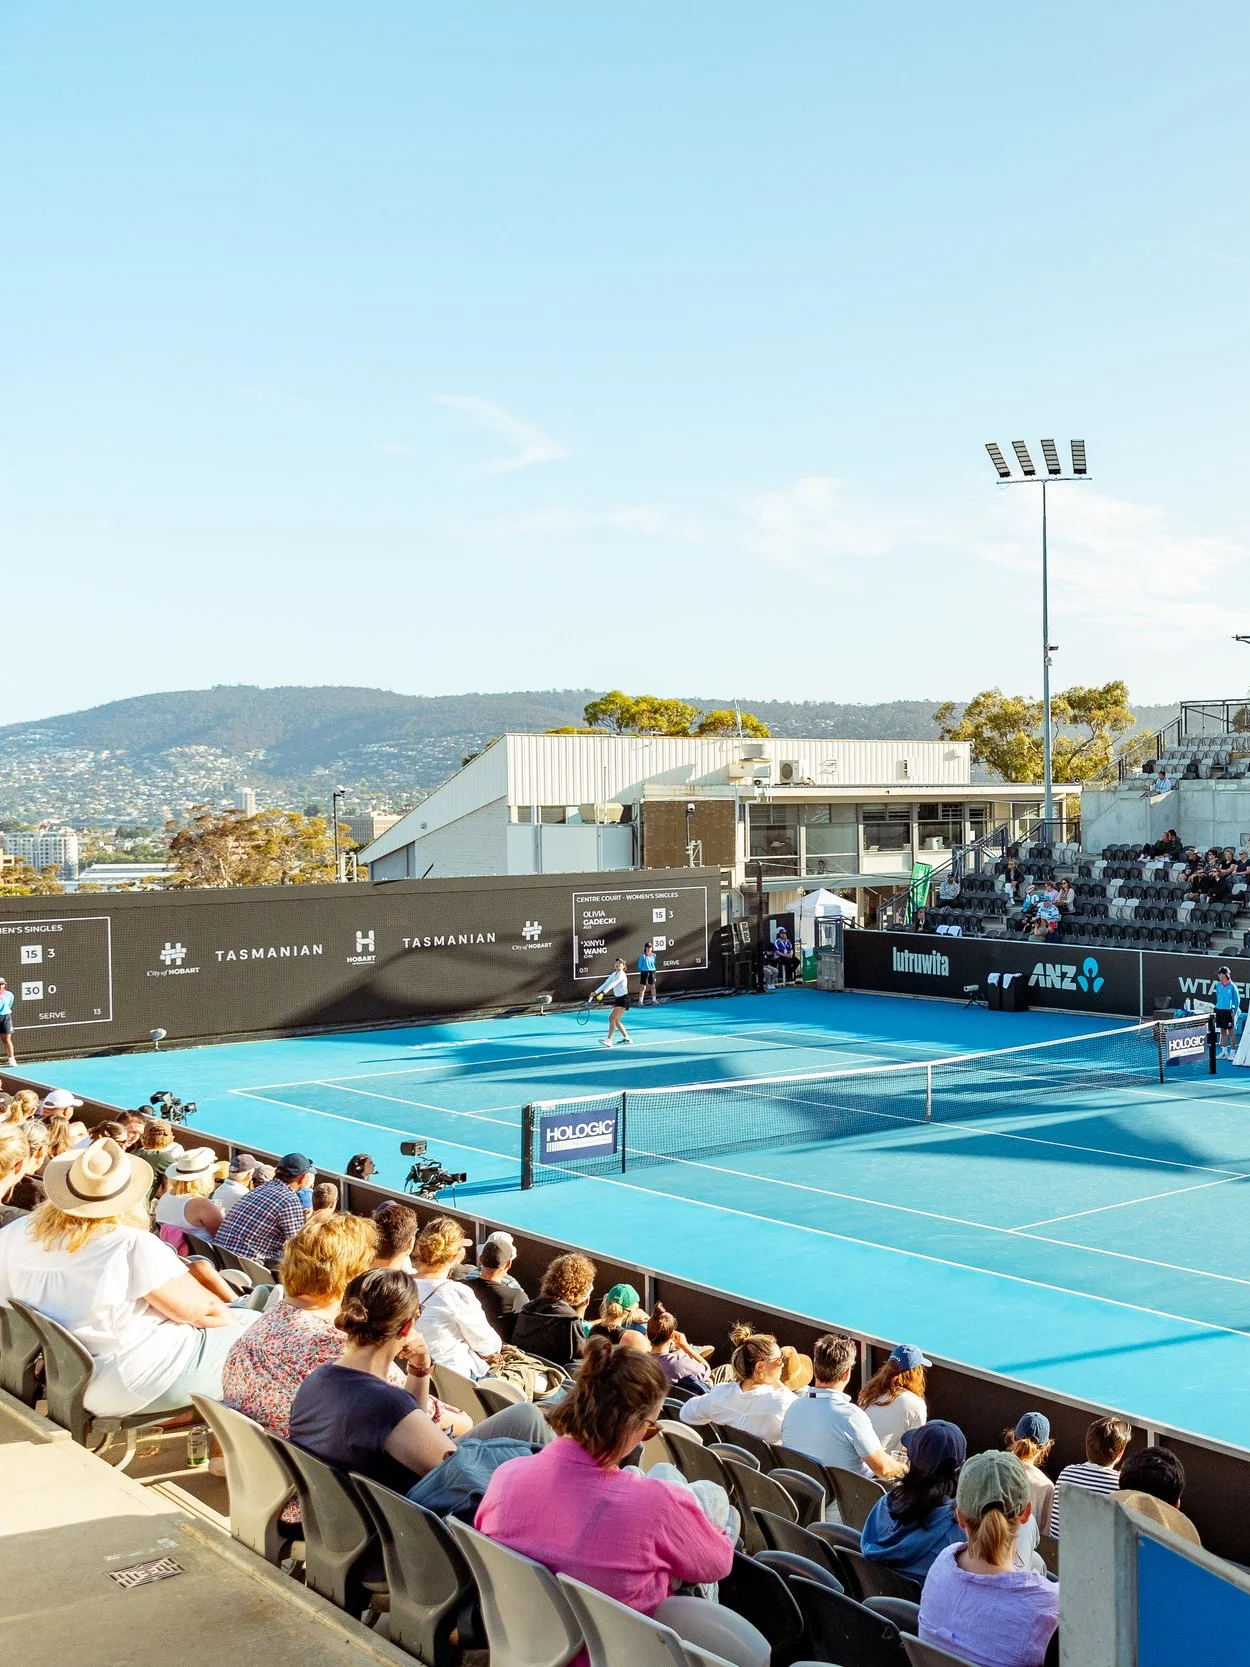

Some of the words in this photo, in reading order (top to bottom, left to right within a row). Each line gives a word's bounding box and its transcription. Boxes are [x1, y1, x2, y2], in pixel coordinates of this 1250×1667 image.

[583, 910, 605, 918] OLIVIA
[655, 911, 663, 919] 15
[669, 910, 674, 918] 3
[583, 917, 616, 926] GADECKI
[24, 924, 63, 934] SINGLES
[402, 932, 496, 949] TASMANIAN
[668, 939, 674, 947] 0
[528, 942, 553, 950] HOBART
[25, 950, 38, 959] 15
[47, 949, 55, 958] 3
[215, 944, 323, 962] TASMANIAN
[583, 947, 608, 955] WANG
[346, 955, 376, 963] HOBART
[892, 946, 950, 977] lutruwita
[168, 967, 200, 975] HOBART
[1027, 962, 1077, 991] ANZ
[24, 986, 40, 995] 30
[48, 985, 57, 994] 0
[39, 1011, 66, 1020] SERVE
[1168, 1035, 1205, 1051] HOLOGIC
[546, 1120, 613, 1142] HOLOGIC
